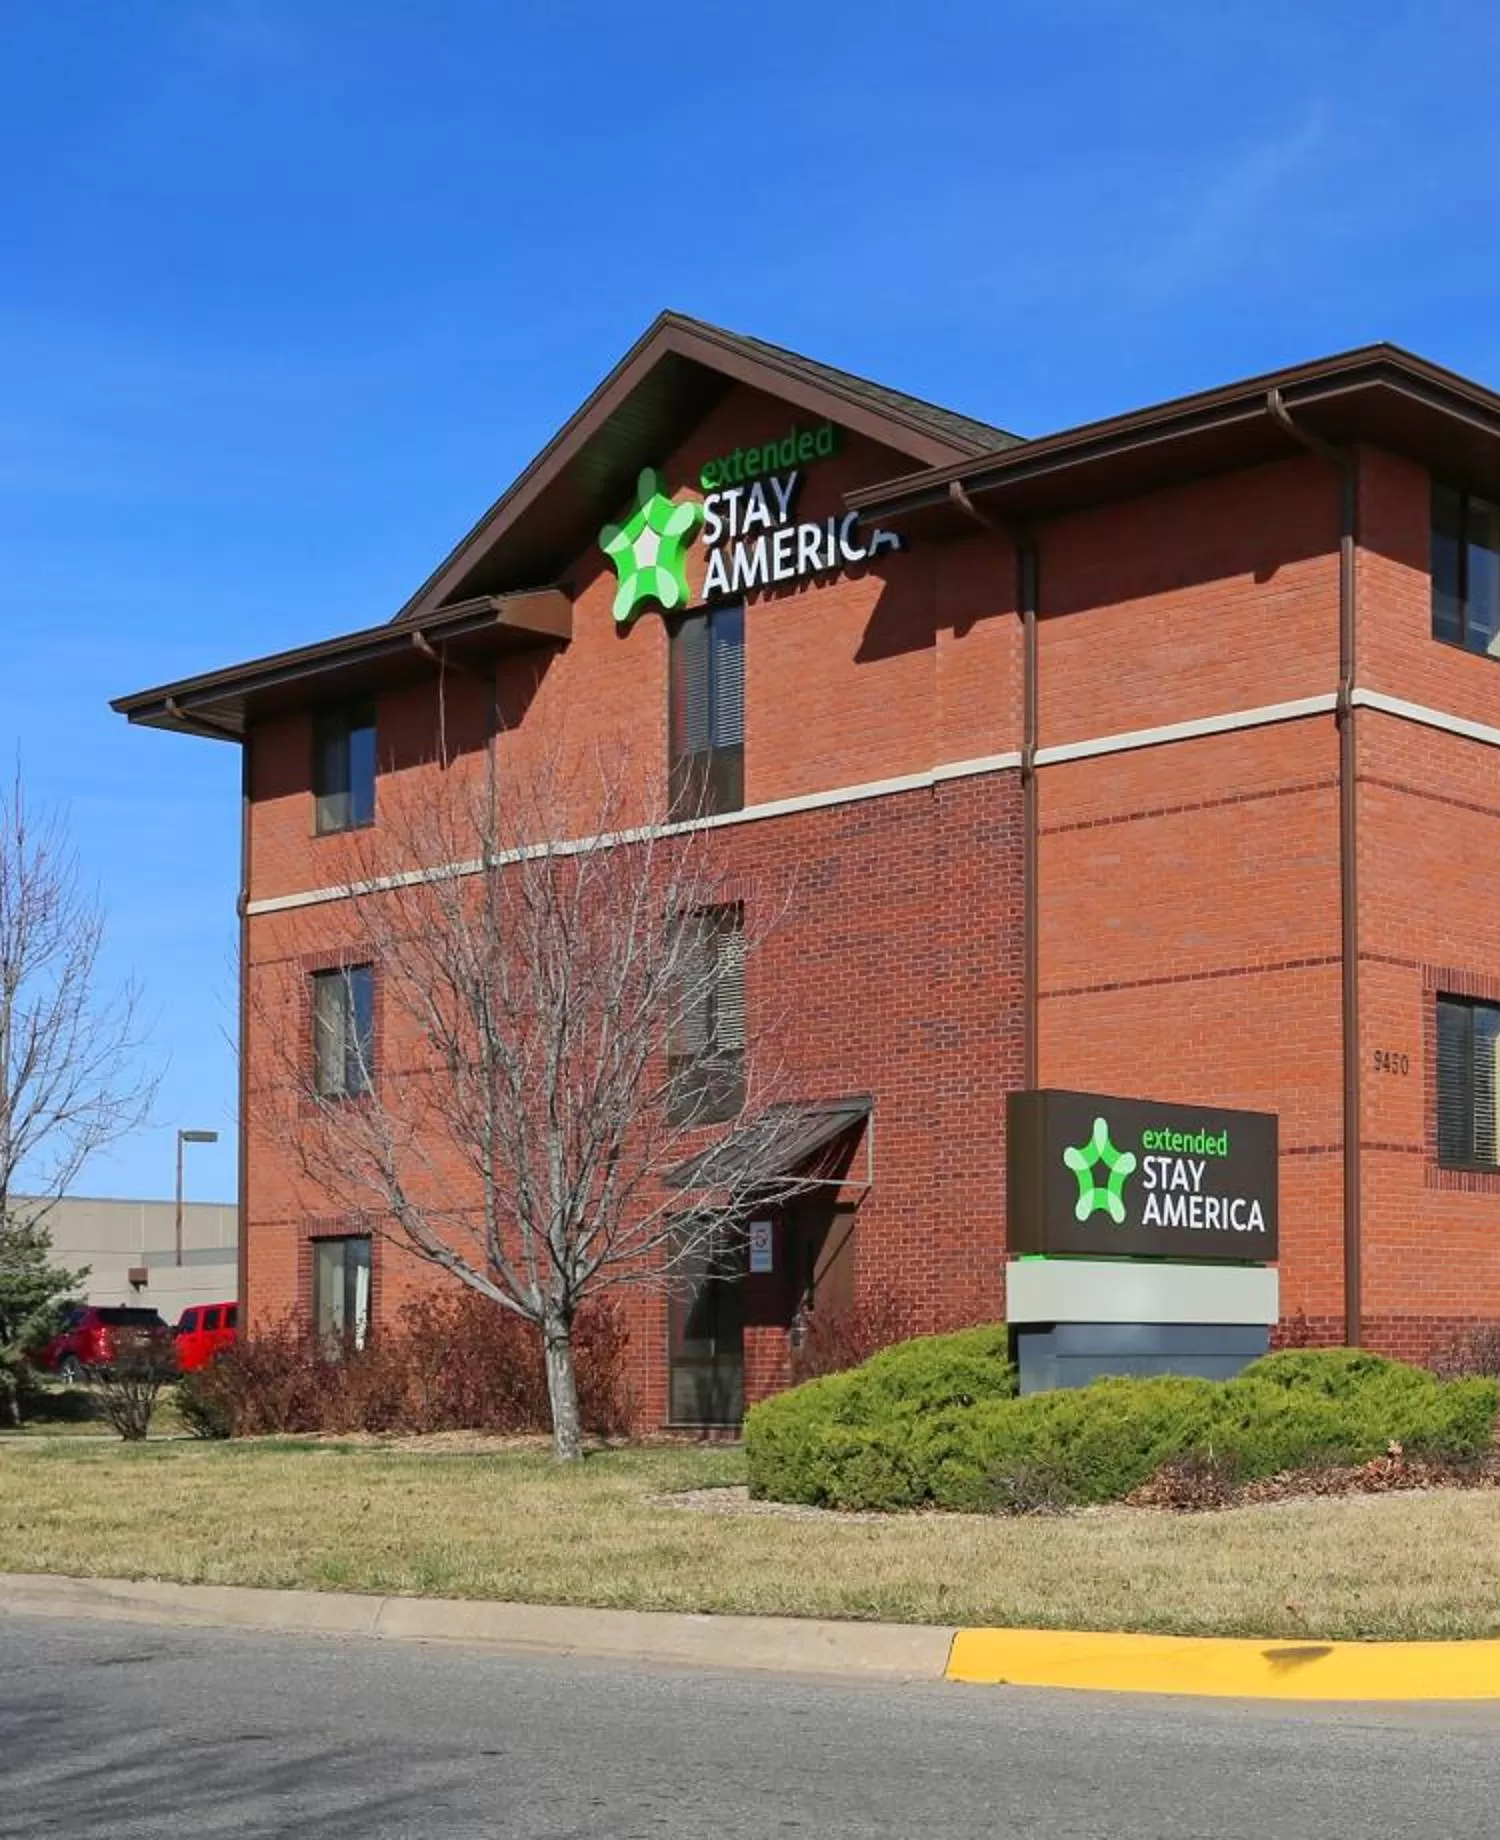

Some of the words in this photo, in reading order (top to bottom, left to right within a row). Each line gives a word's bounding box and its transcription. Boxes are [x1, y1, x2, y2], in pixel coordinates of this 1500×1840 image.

[701, 423, 833, 488] extended
[702, 471, 798, 545] STAY
[1142, 1127, 1228, 1157] extended
[1142, 1156, 1206, 1193] STAY
[1141, 1193, 1266, 1233] AMERICA
